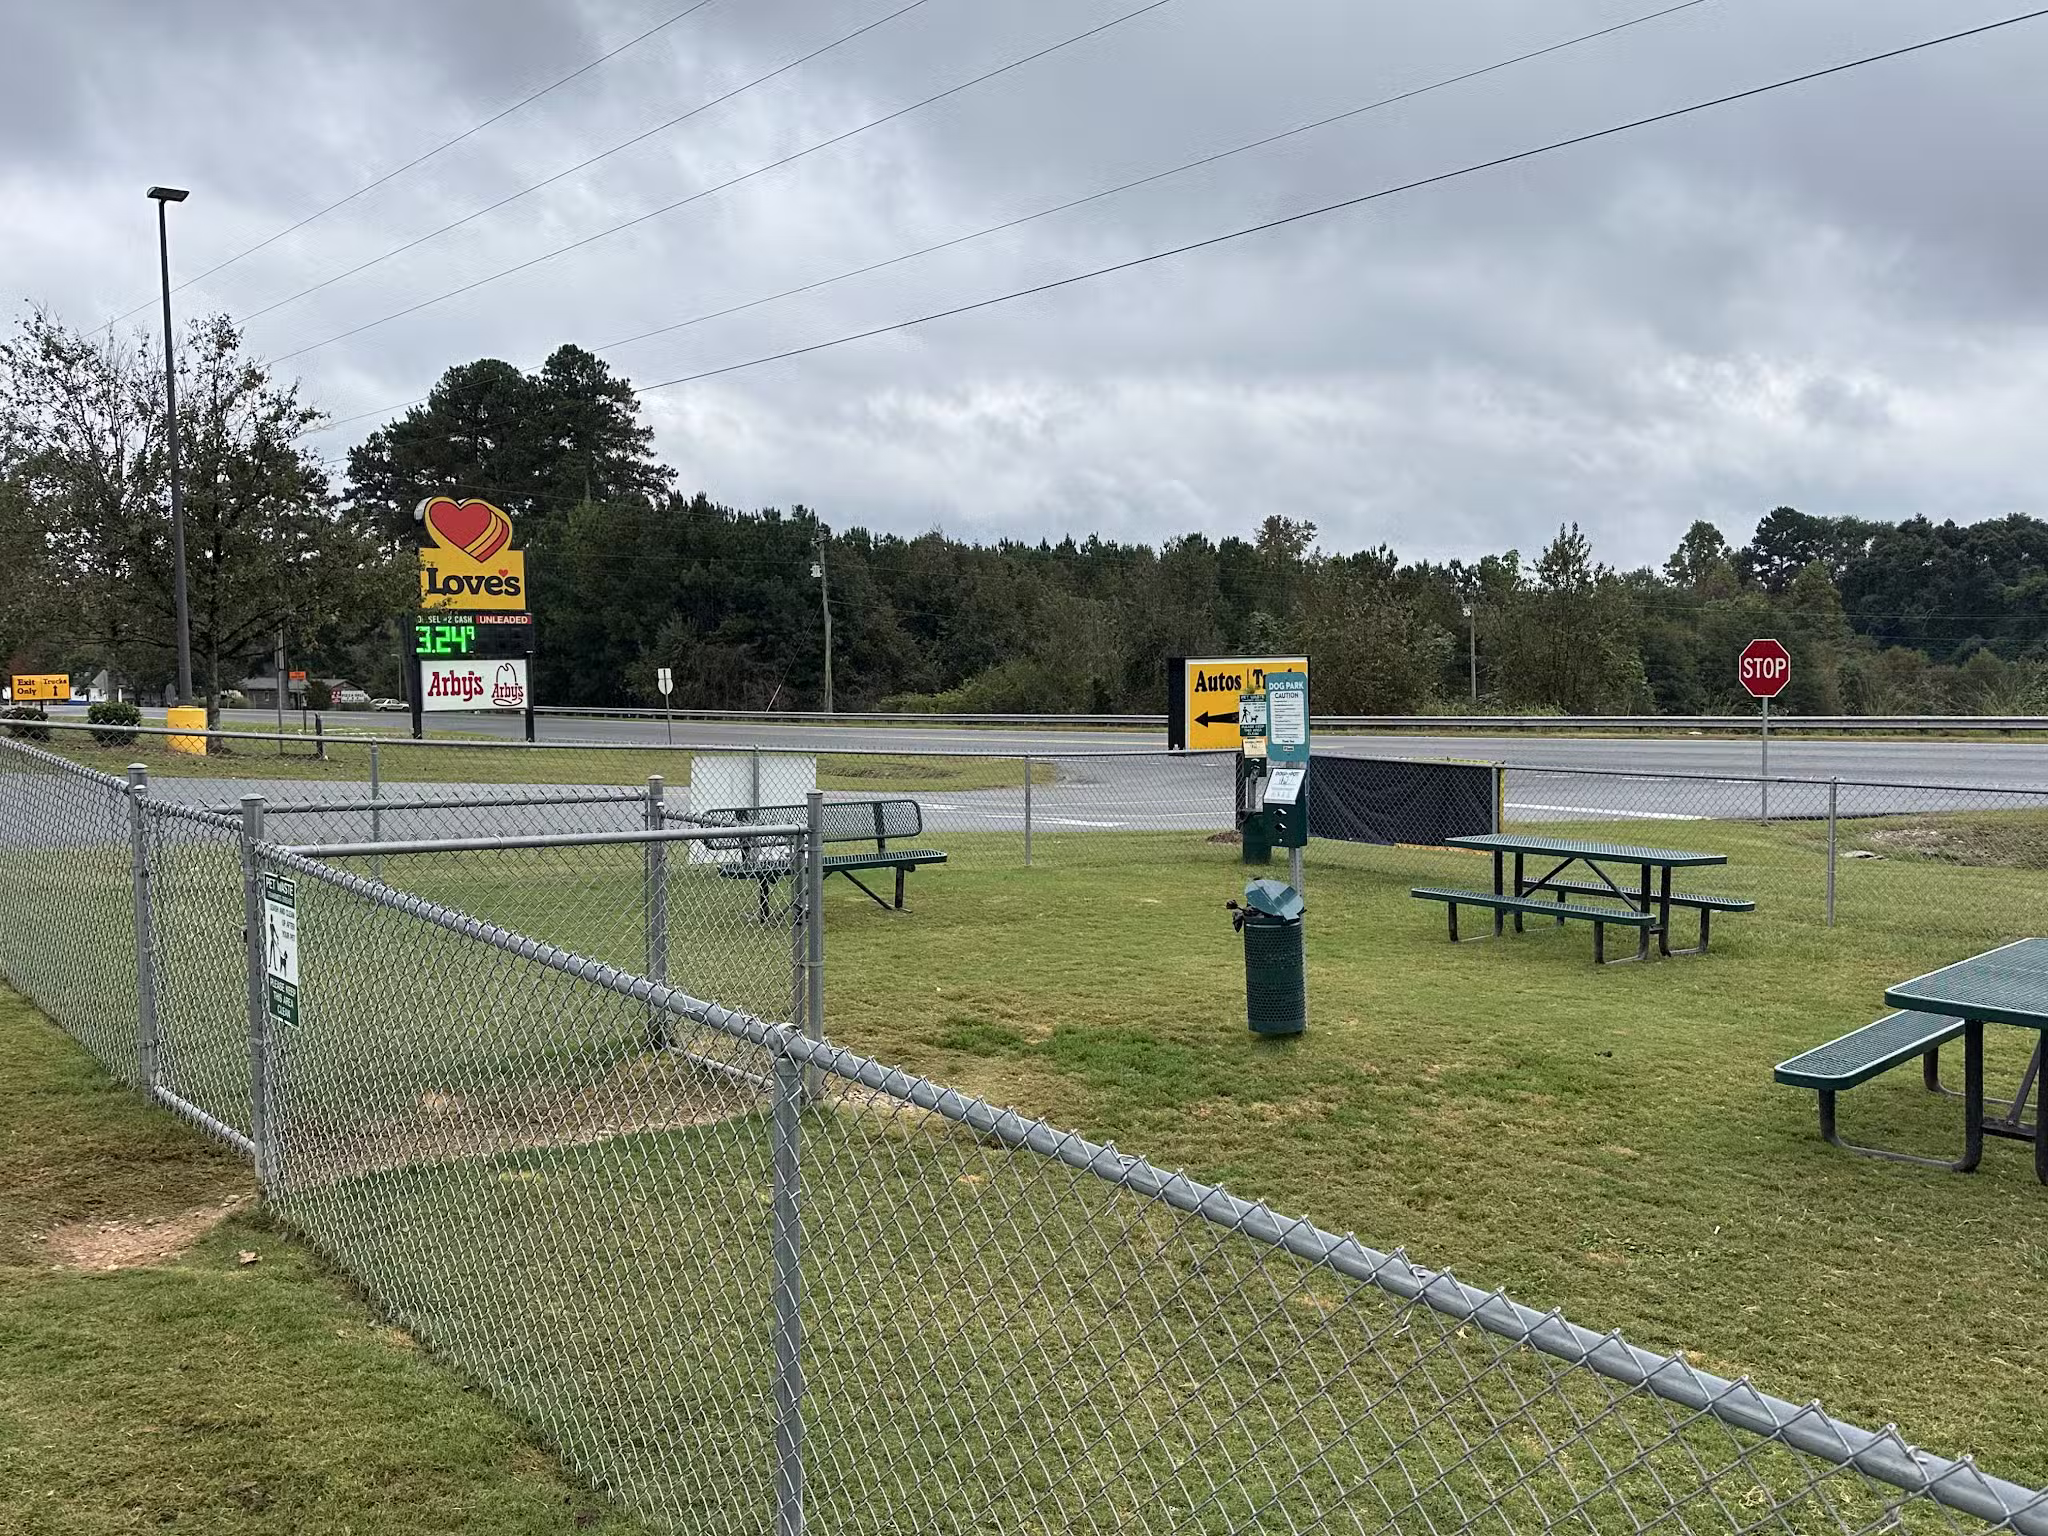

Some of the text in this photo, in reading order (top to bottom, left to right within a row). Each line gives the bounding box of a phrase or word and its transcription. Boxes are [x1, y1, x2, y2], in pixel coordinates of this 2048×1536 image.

[454, 615, 472, 624] CASH
[479, 616, 528, 624] UNLEADED
[1743, 658, 1786, 678] STOP
[428, 670, 484, 702] Arby's
[1194, 670, 1242, 692] Autos
[1268, 681, 1304, 690] DOG PARK
[17, 687, 36, 695] Only
[492, 683, 523, 701] Arby's
[265, 876, 294, 897] PET WASTE
[270, 977, 296, 998] PLEASE KEEP
[273, 990, 294, 1010] THIS AREA
[277, 1004, 291, 1018] CLEAN
